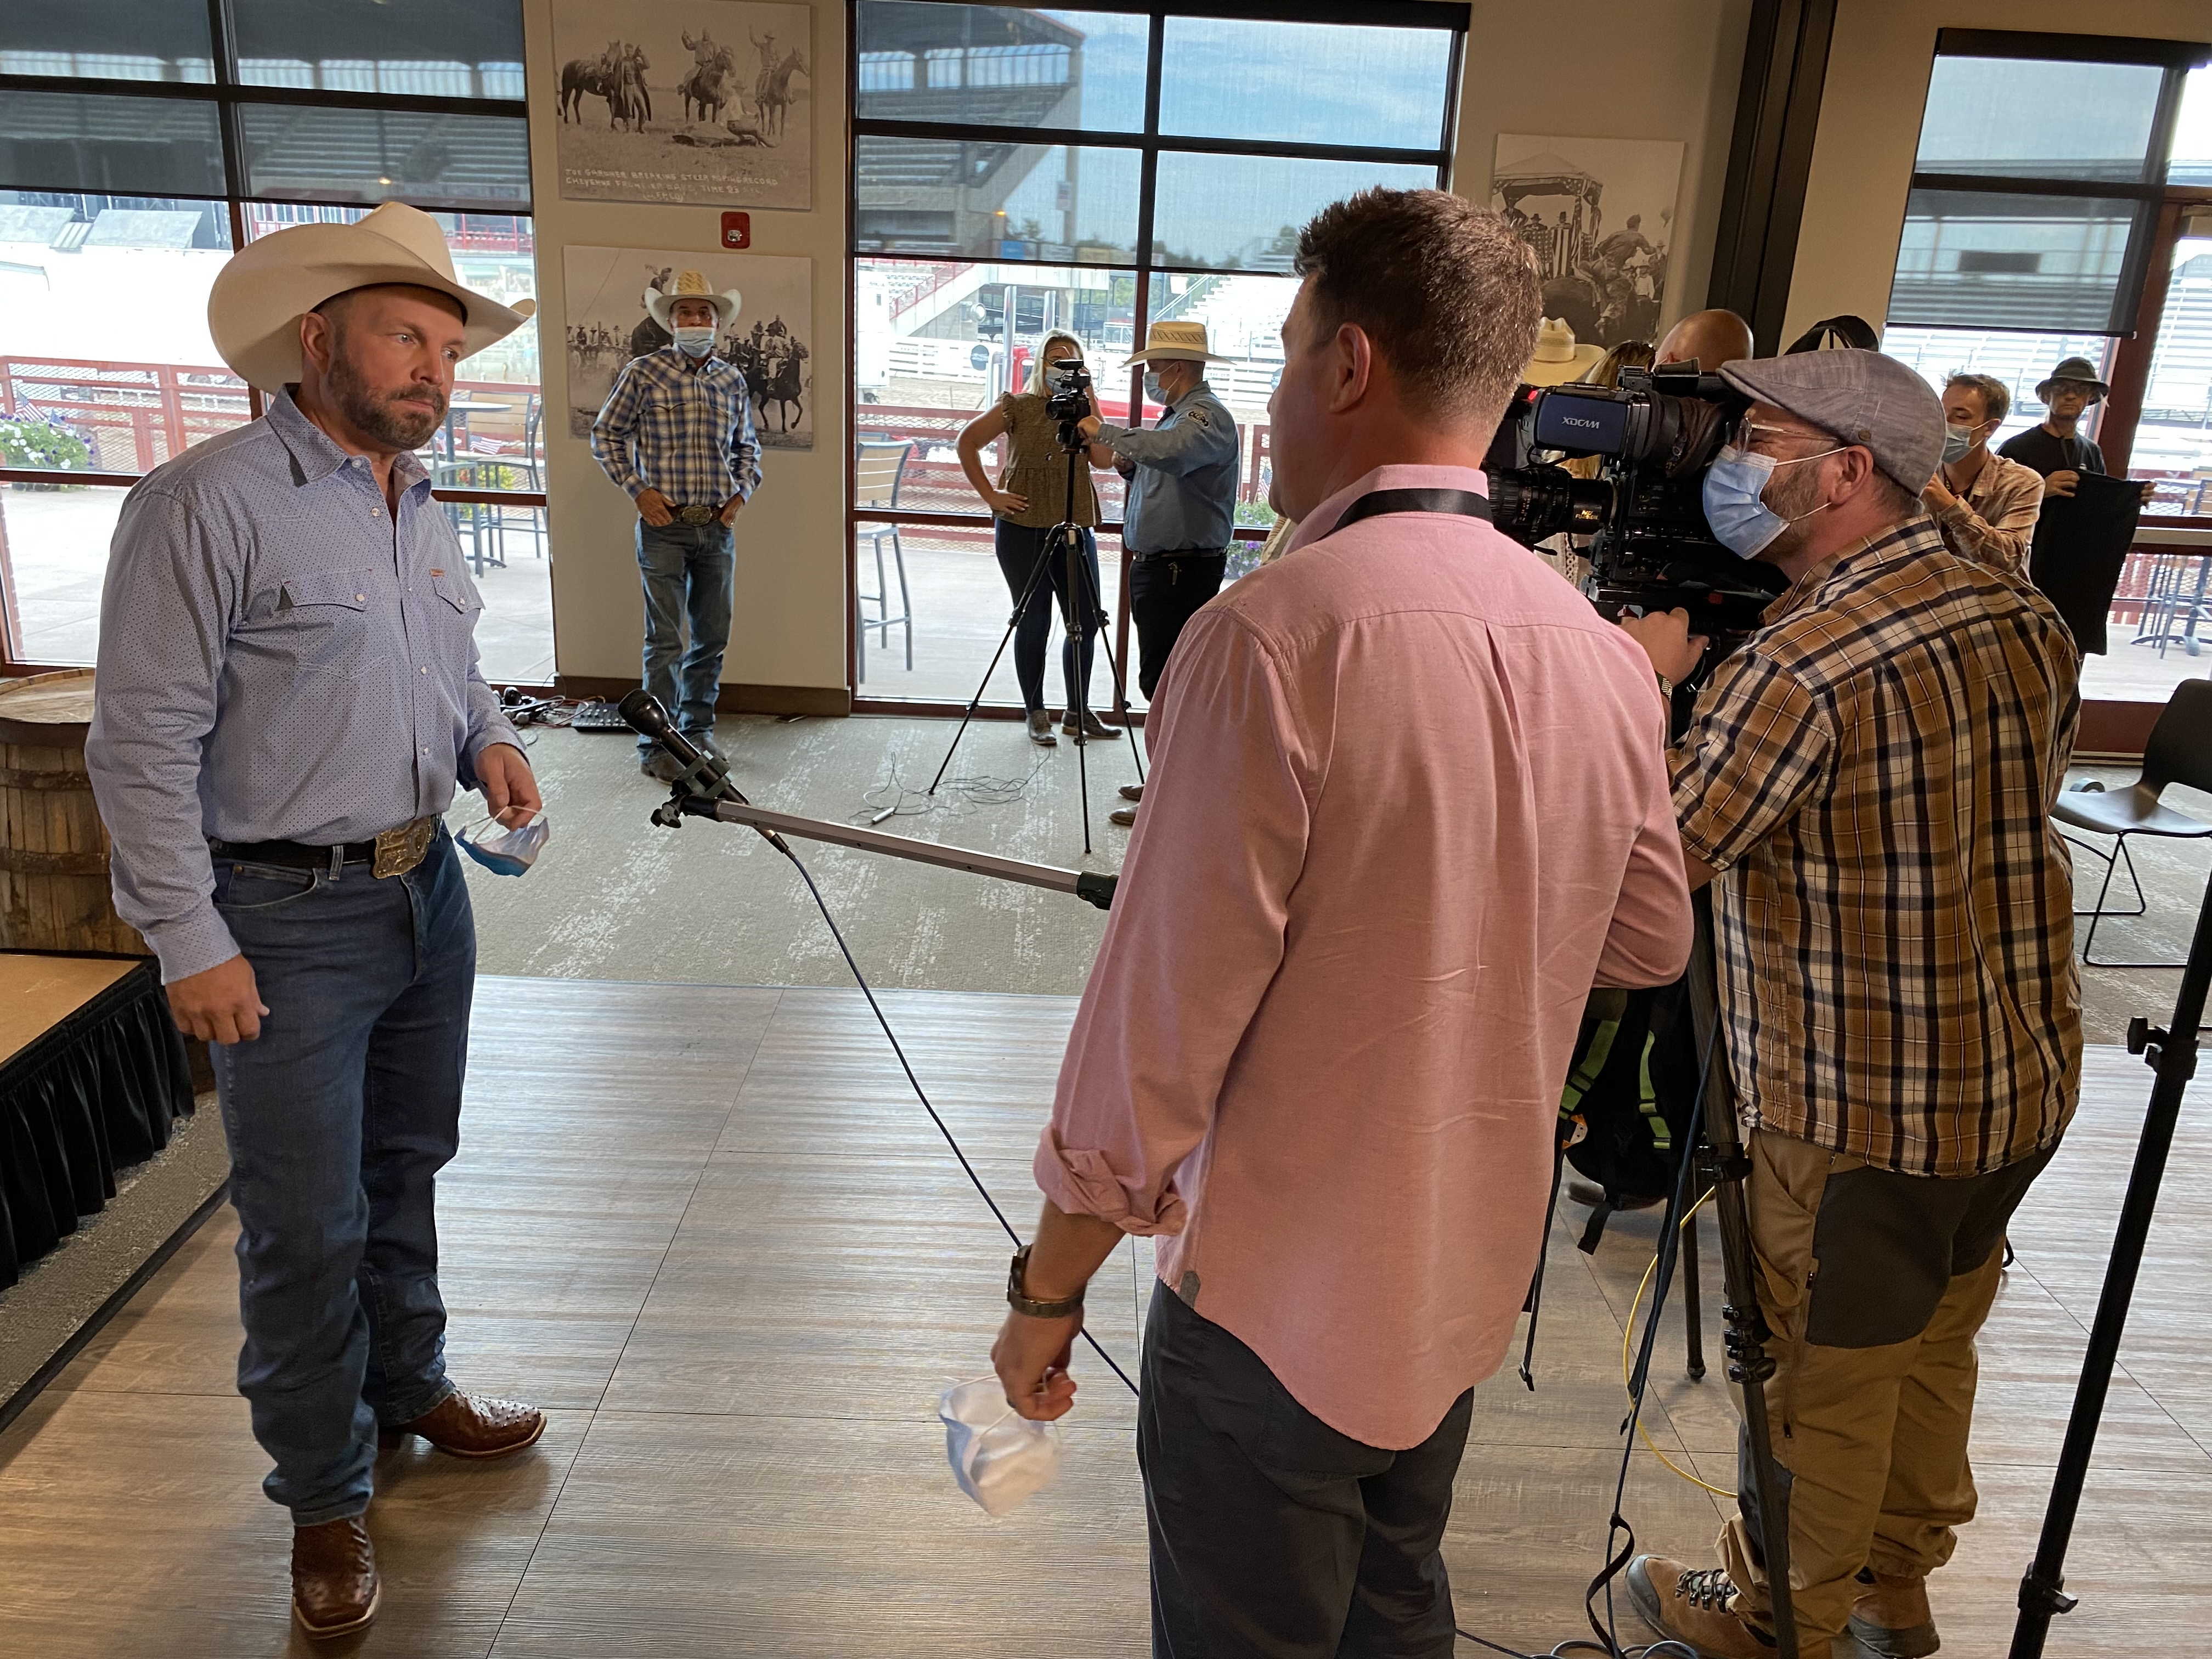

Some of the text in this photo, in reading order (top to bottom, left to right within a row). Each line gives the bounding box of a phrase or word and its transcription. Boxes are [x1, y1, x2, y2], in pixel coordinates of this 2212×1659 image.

[566, 177, 611, 187] CHEYENNE
[631, 172, 676, 181] BREAKING
[712, 175, 741, 183] ROPING
[743, 177, 778, 186] RECORD
[1561, 417, 1600, 428] XDCAM
